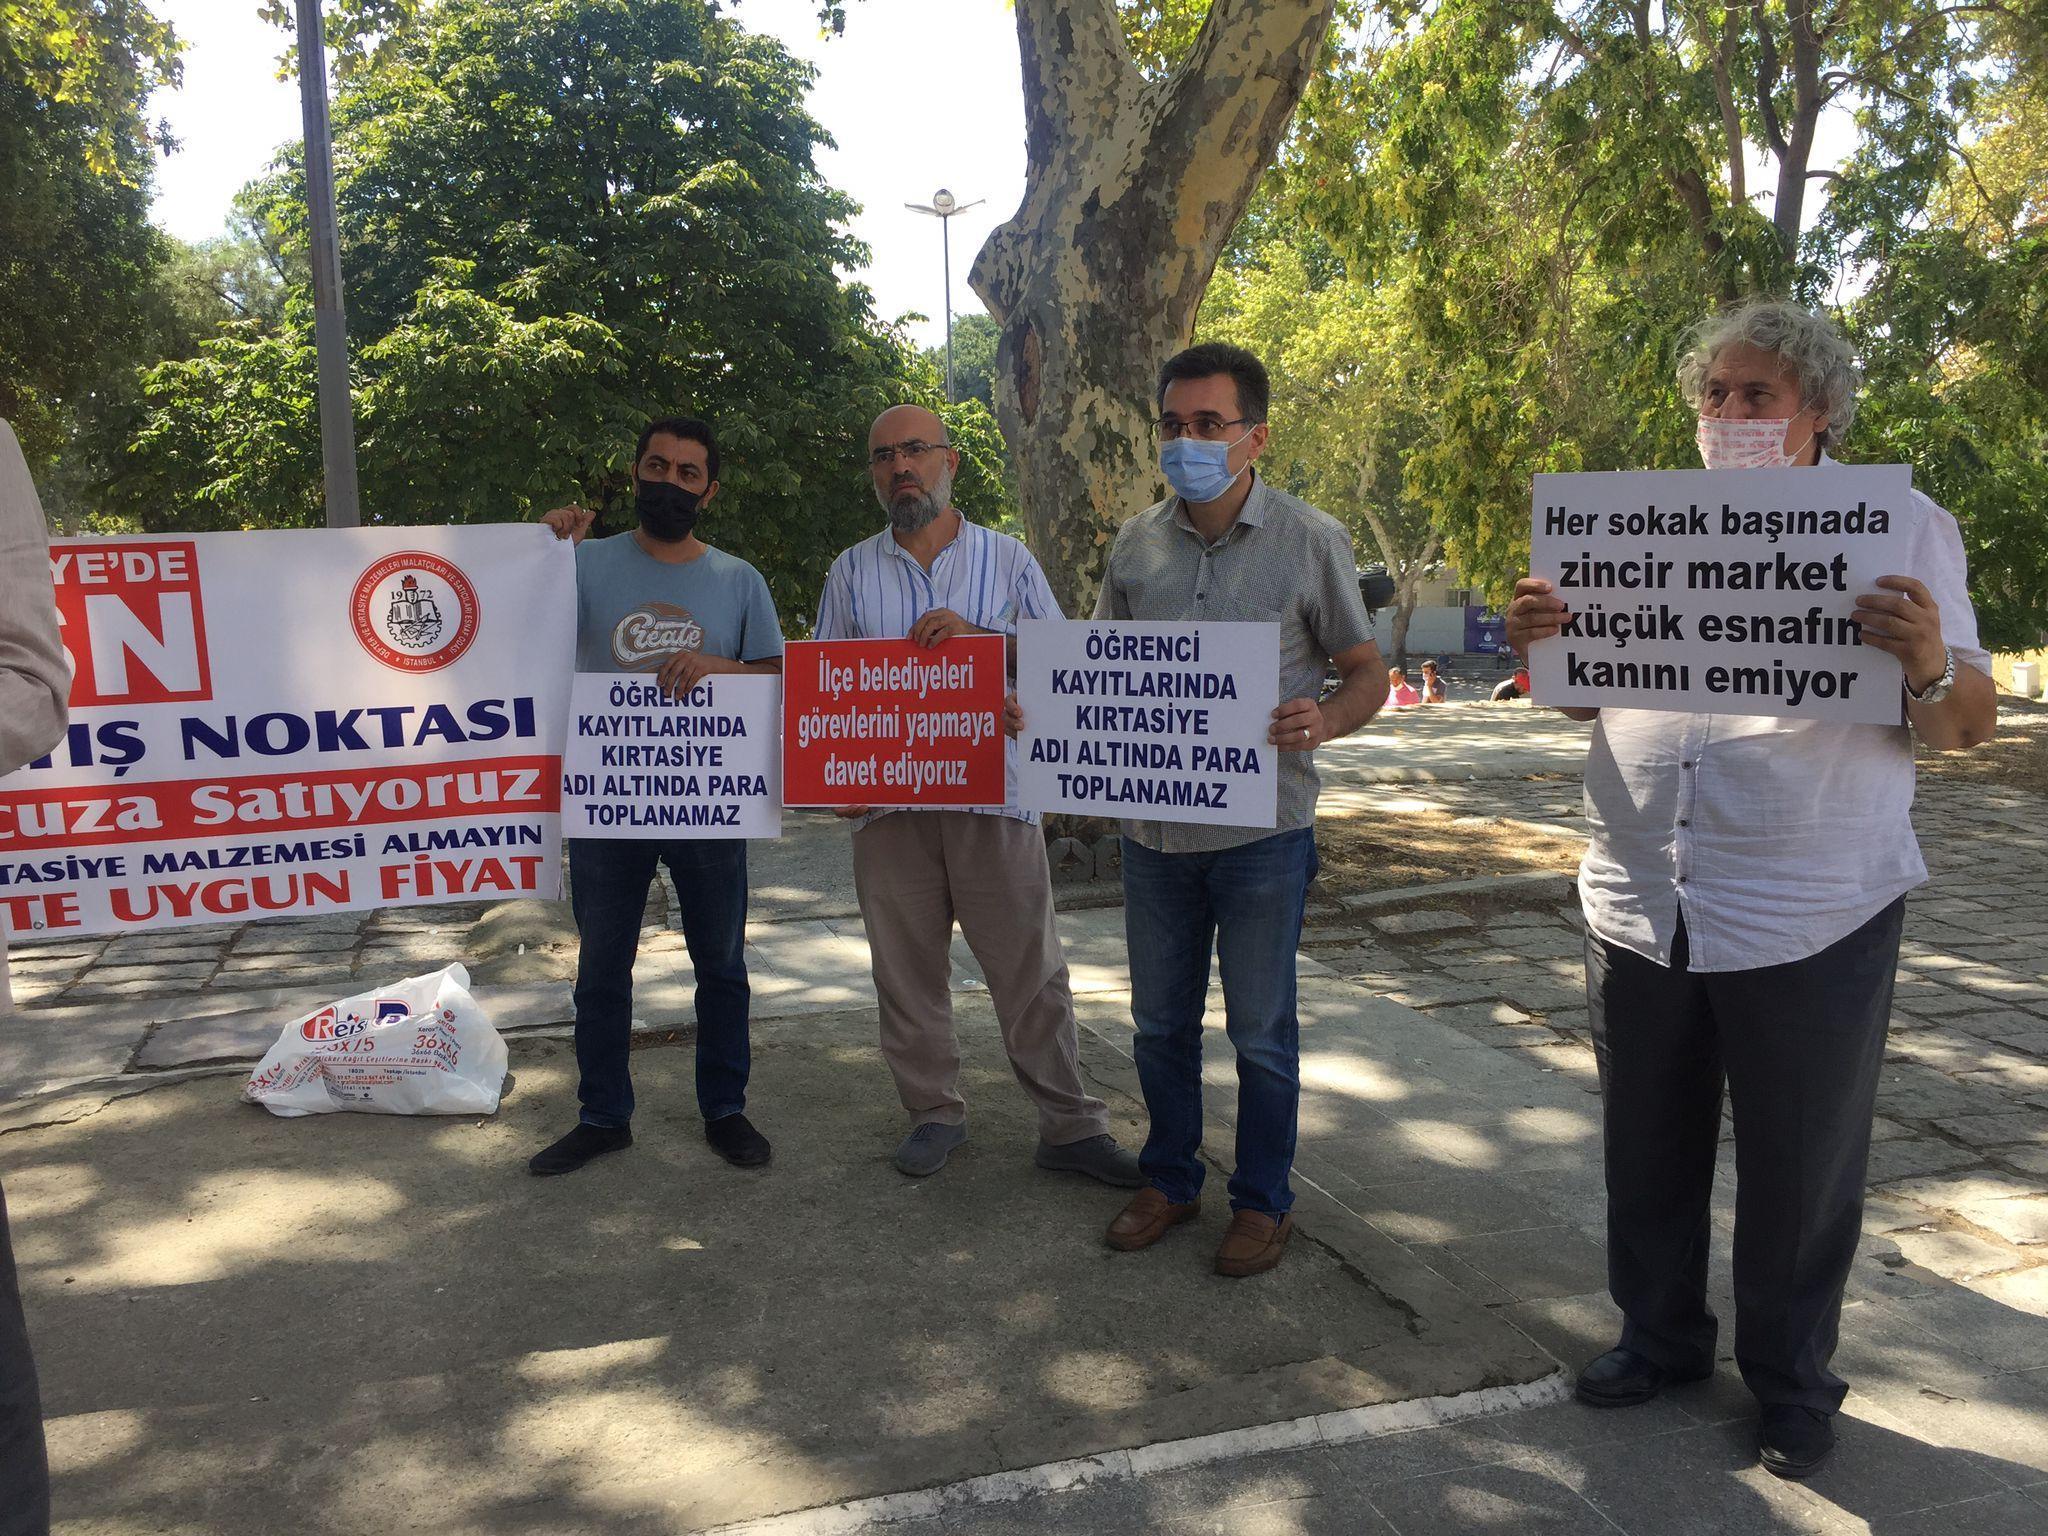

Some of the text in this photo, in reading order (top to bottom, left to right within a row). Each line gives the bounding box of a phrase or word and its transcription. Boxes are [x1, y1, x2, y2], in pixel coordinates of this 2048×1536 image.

[1545, 502, 1889, 543] Her sokak başınada
[1560, 552, 1847, 592] zincir market
[391, 590, 434, 600] 19 72
[613, 610, 702, 664] Create
[1086, 629, 1200, 662] ÖĞRENCİ
[1560, 603, 1863, 648] küçük esnafın
[818, 651, 974, 700] İlçe belediyeleri
[1051, 669, 1237, 700] KAYITLARINDA
[1567, 652, 1858, 706] kanını emiyor
[30, 697, 536, 777] IŞ NOKTASI
[578, 715, 747, 737] KAYITLARINDA
[798, 705, 995, 748] görevlerini yapmaya
[1076, 702, 1209, 735] KIRTASİYE
[601, 741, 723, 767] KIRTASİYE
[824, 752, 968, 794] davet ediyoruz
[1030, 739, 1260, 774] ADI ALTINDA PARA
[191, 767, 542, 828] Satıyoruz
[564, 774, 768, 796] ADI ALTINDA PARA
[1057, 774, 1228, 808] TOPLANAMAZ
[585, 804, 741, 826] TOPLANAMAZ
[143, 832, 366, 875] MALZEMESİ
[382, 824, 543, 855] ALMAYIN
[110, 869, 351, 922] UYGUN
[380, 854, 544, 897] FİYAT
[309, 1011, 367, 1040] Reis
